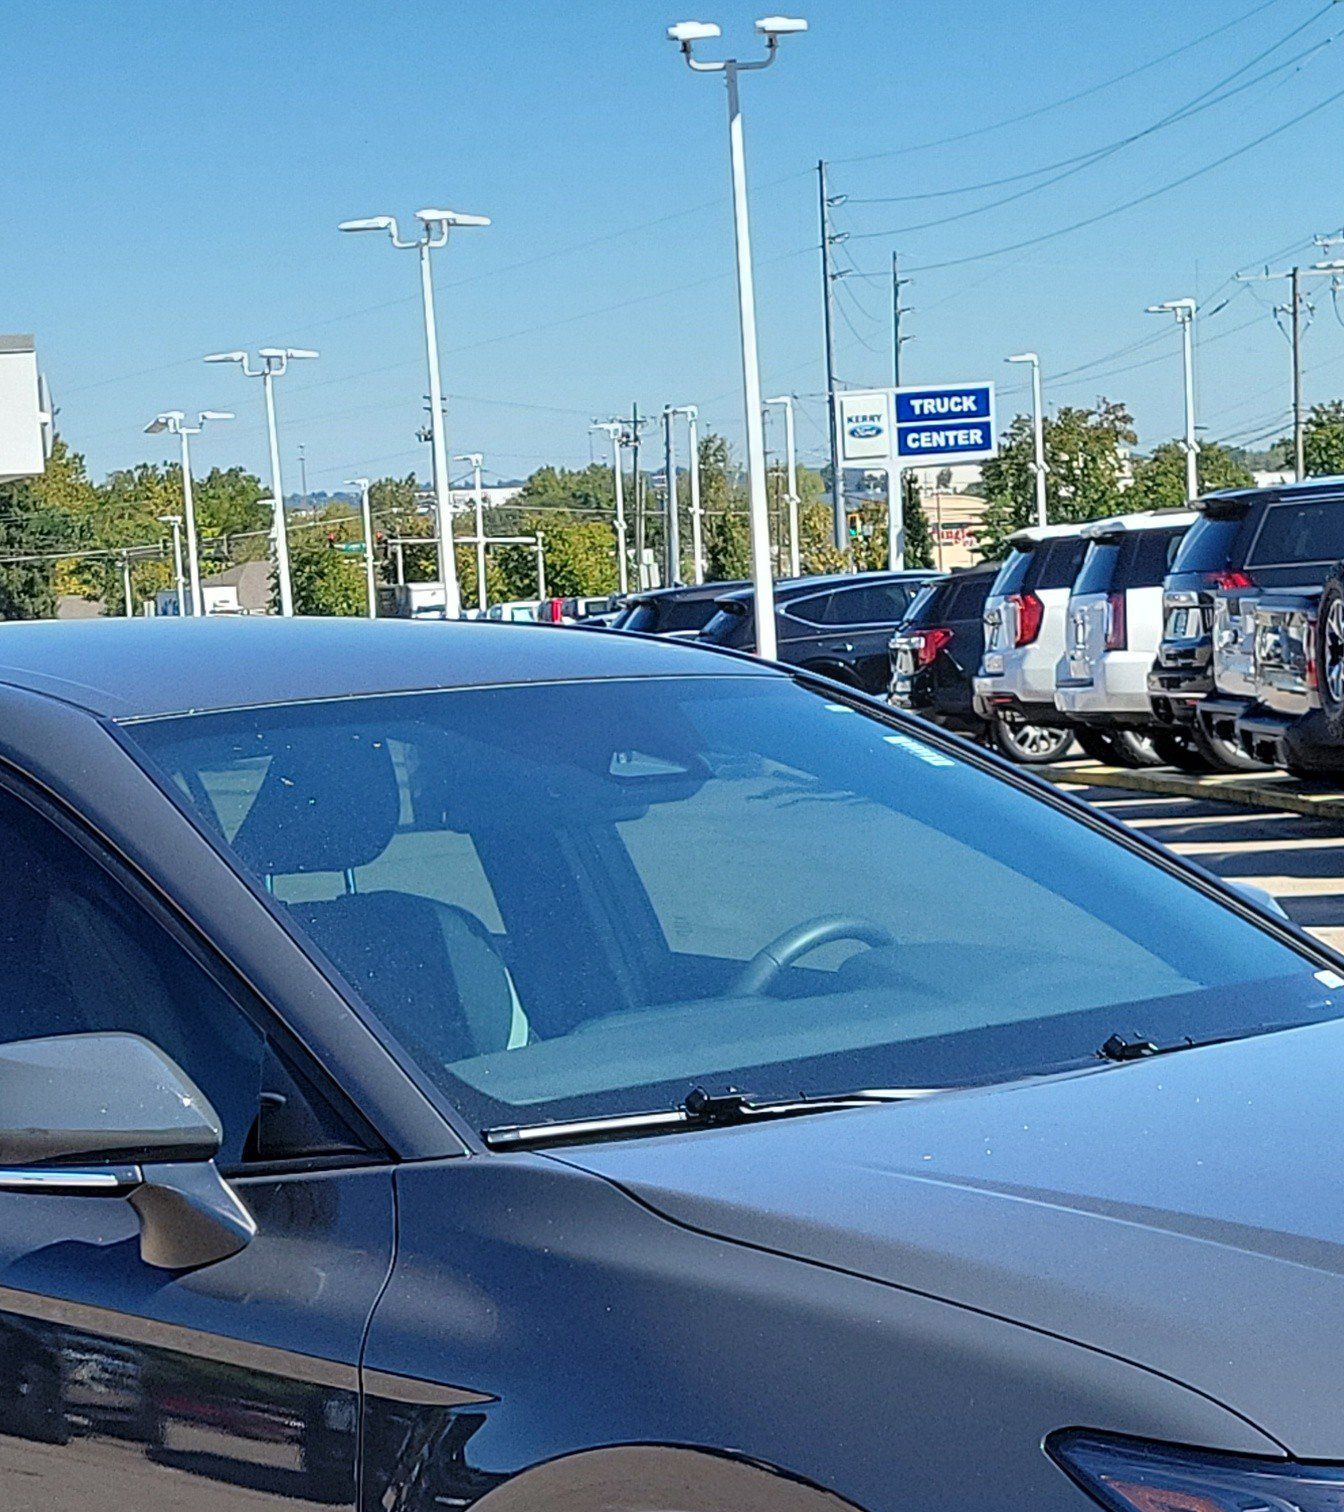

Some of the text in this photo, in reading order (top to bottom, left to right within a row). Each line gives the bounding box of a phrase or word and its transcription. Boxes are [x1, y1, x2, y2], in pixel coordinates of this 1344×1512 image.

[909, 395, 978, 416] TRUCK
[847, 414, 882, 423] KERRY
[906, 428, 984, 449] CENTER
